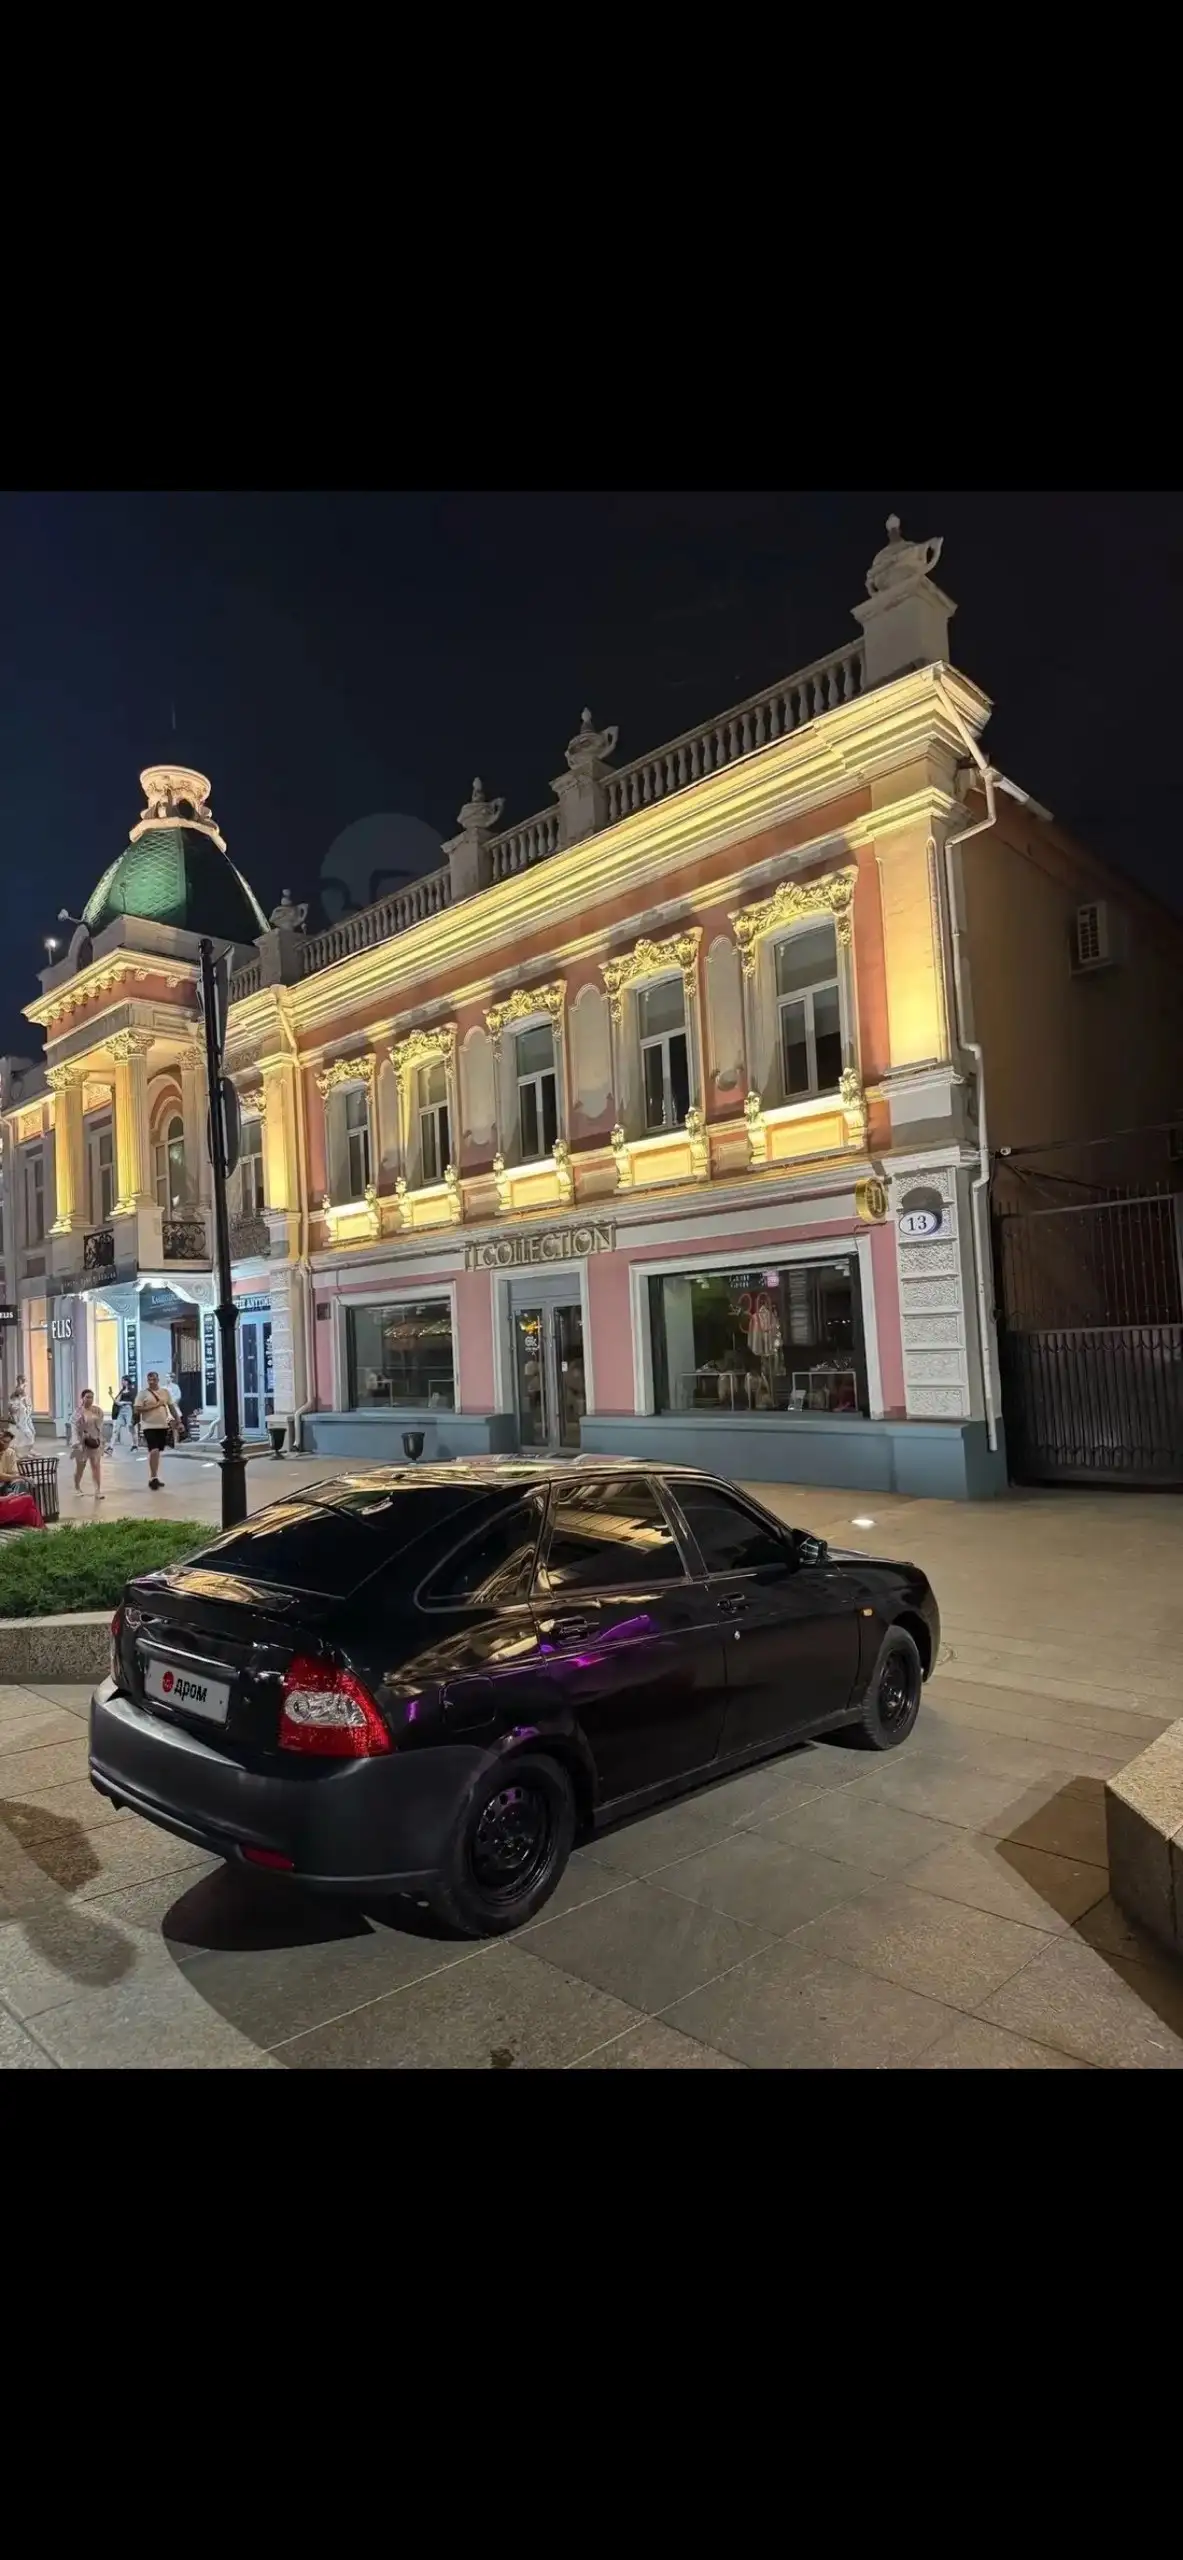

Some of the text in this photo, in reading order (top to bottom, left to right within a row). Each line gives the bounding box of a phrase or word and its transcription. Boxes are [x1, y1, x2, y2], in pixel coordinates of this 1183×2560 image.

[907, 1215, 928, 1231] 13
[482, 1224, 617, 1268] COLLECTION
[51, 1319, 72, 1339] ELIS
